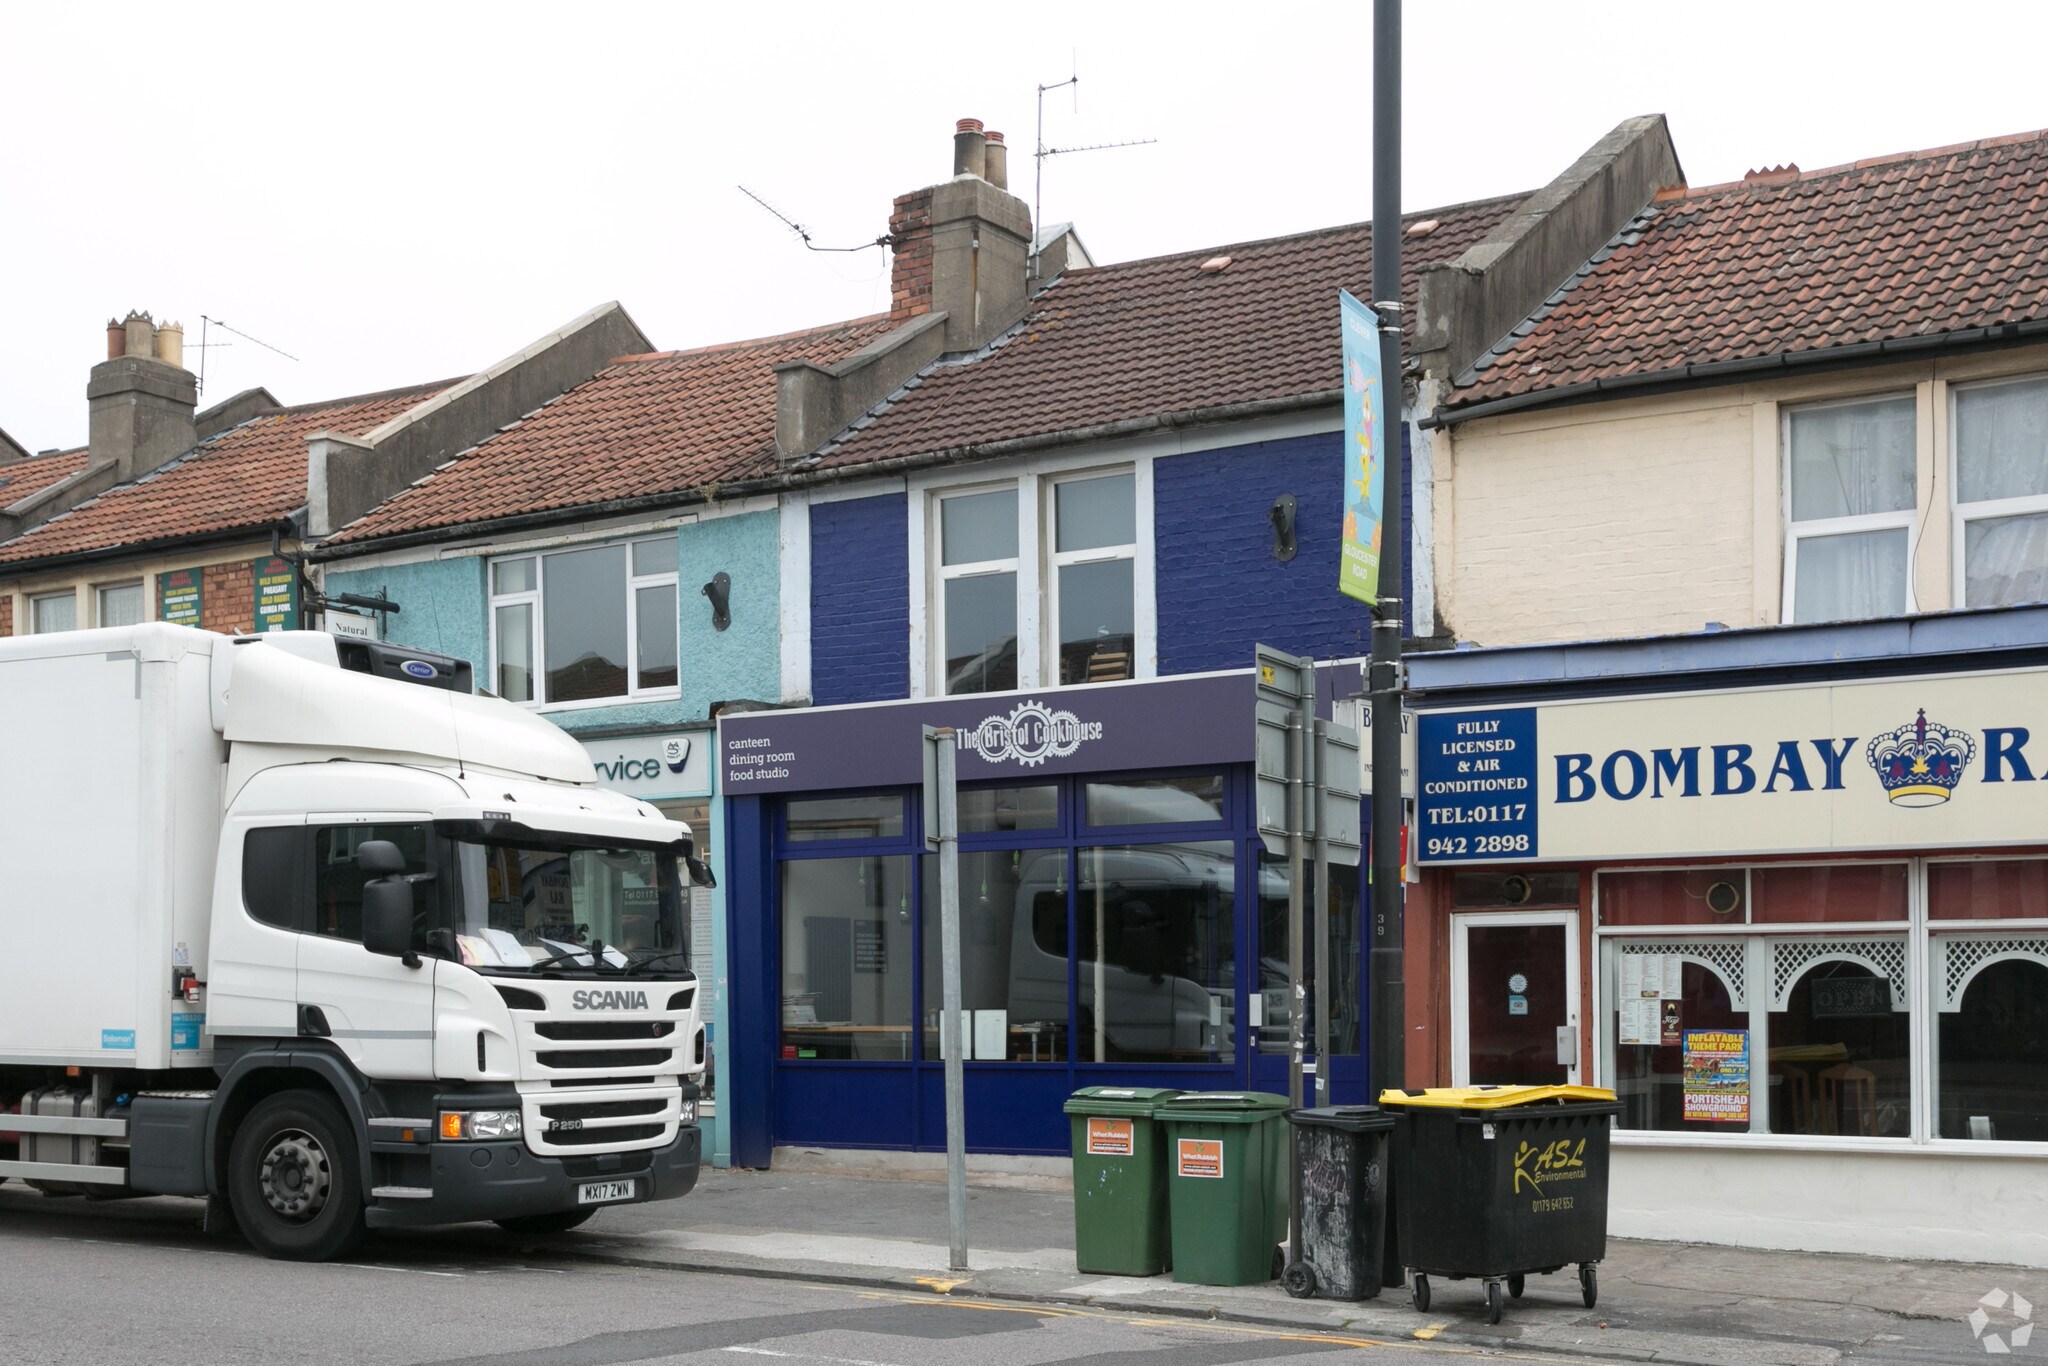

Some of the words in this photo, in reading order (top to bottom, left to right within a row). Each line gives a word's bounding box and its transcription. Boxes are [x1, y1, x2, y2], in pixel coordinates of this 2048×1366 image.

[1344, 543, 1378, 568] GLOUCESTER
[1352, 563, 1368, 580] ROAD
[263, 584, 287, 595] PHEASANT
[260, 605, 277, 614] GUINEA
[277, 603, 292, 613] FOWL
[267, 614, 284, 623] PIGEON
[336, 622, 368, 636] Natural
[409, 664, 431, 676] Carrier
[956, 728, 978, 750] The
[984, 721, 1029, 748] Bristol
[1034, 720, 1103, 744] Cookhouse
[1457, 720, 1500, 734] FULLY
[729, 737, 771, 750] canteen
[1442, 739, 1516, 755] LICENSED
[729, 754, 764, 767] dining
[766, 750, 795, 763] room
[1457, 760, 1471, 773] &
[1474, 758, 1500, 772] AIR
[729, 768, 754, 782] food
[756, 766, 789, 780] studio
[1553, 737, 1859, 804] BOMBAY
[1425, 777, 1528, 794] CONDITIONED
[1427, 804, 1527, 825] TEL:0117
[1428, 836, 1468, 855] 942
[1475, 834, 1529, 853] 2898
[624, 890, 635, 899] Tel
[572, 989, 649, 1011] SCANIA
[1687, 1033, 1744, 1043] INFLATABLE
[1688, 1042, 1718, 1051] THEME
[1719, 1042, 1744, 1052] PARK
[1685, 1094, 1748, 1105] PORTISHEAD
[1685, 1103, 1742, 1112] SHOWGROUND
[1534, 1138, 1586, 1172] ASL
[1534, 1168, 1587, 1184] Environmental
[585, 1184, 608, 1201] MX17
[610, 1182, 629, 1198] ZWN
